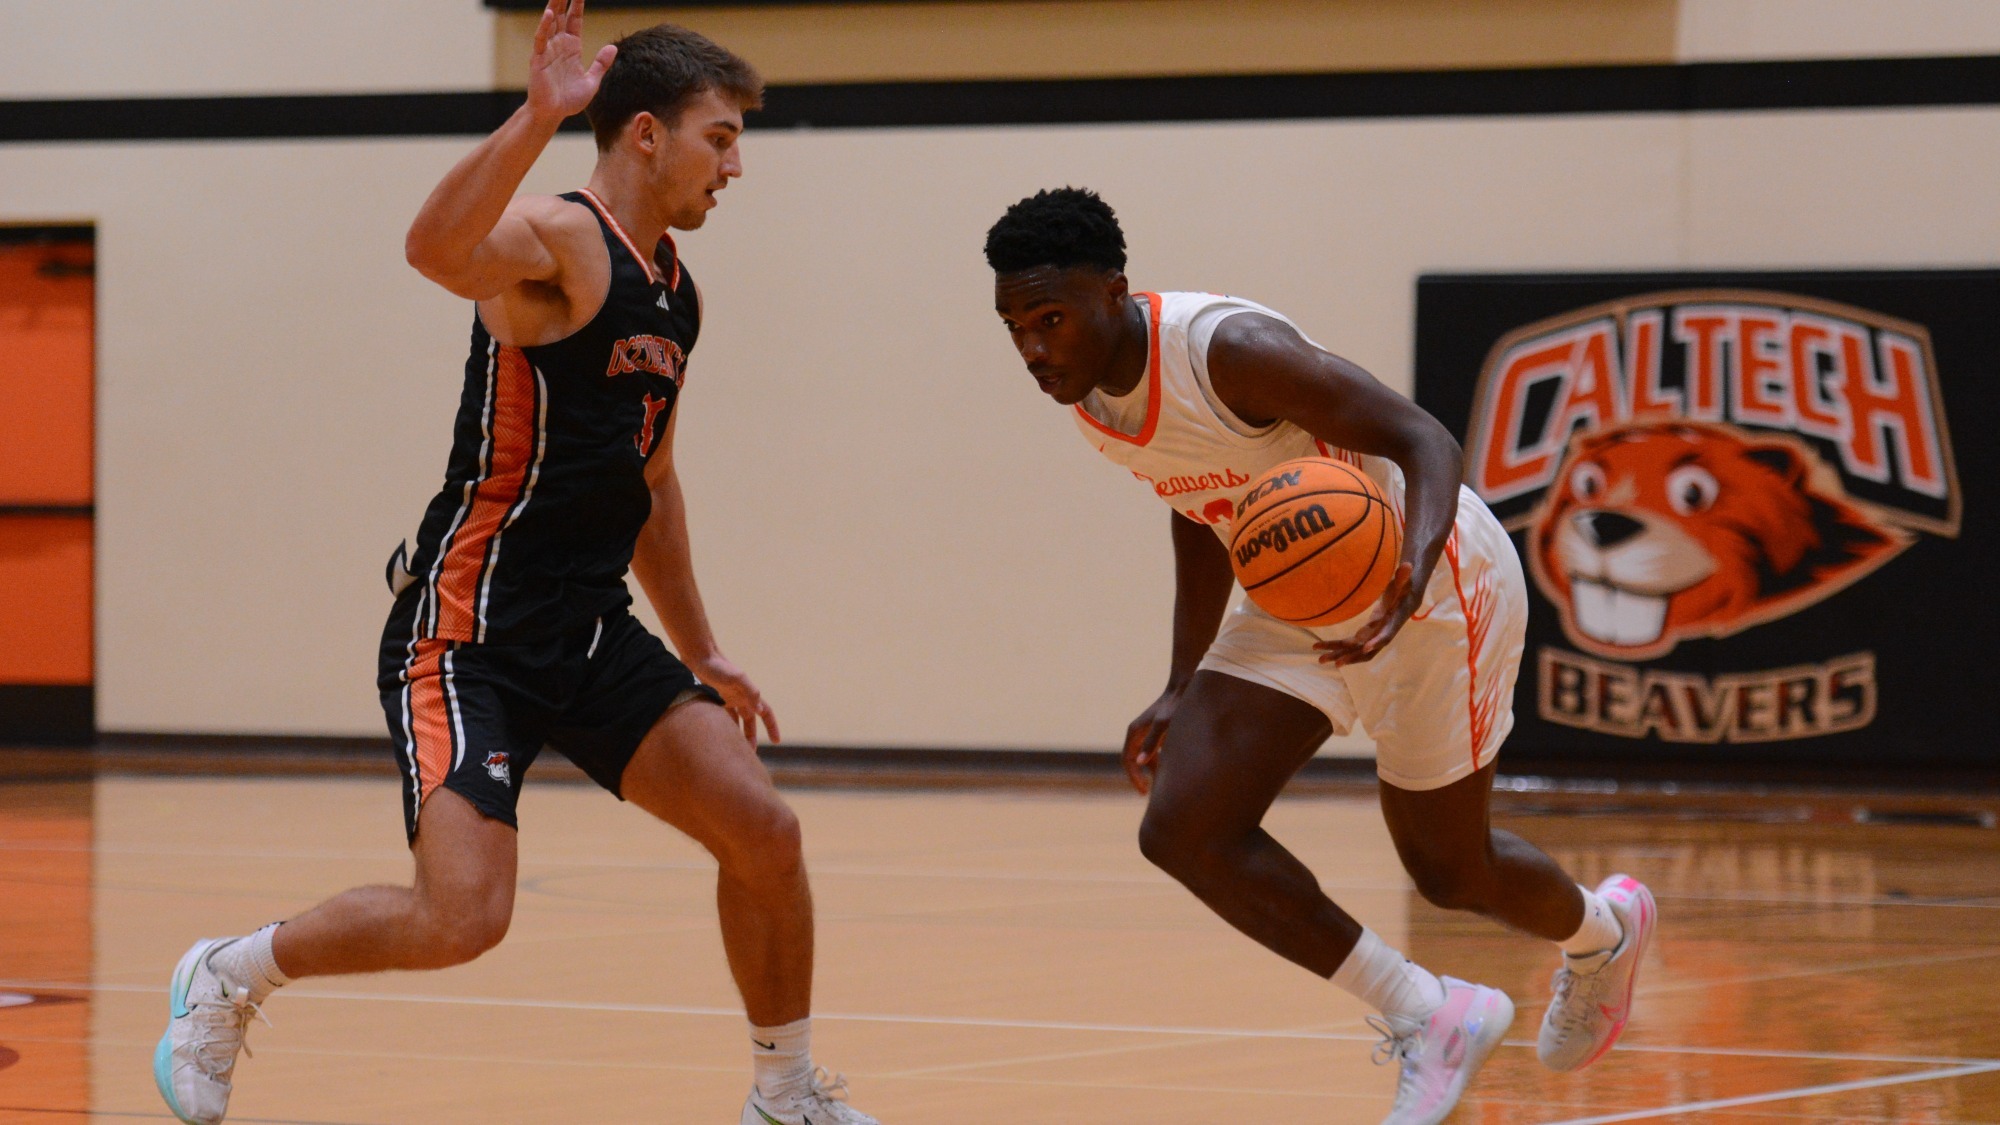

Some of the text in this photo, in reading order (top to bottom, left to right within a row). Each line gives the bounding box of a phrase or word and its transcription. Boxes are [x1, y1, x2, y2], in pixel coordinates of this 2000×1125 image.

[1476, 304, 1948, 504] CALTECH
[1132, 468, 1250, 498] eavers
[1237, 469, 1302, 520] NCAA
[1236, 503, 1335, 568] Wilson
[1538, 651, 1876, 743] BEAVERS
